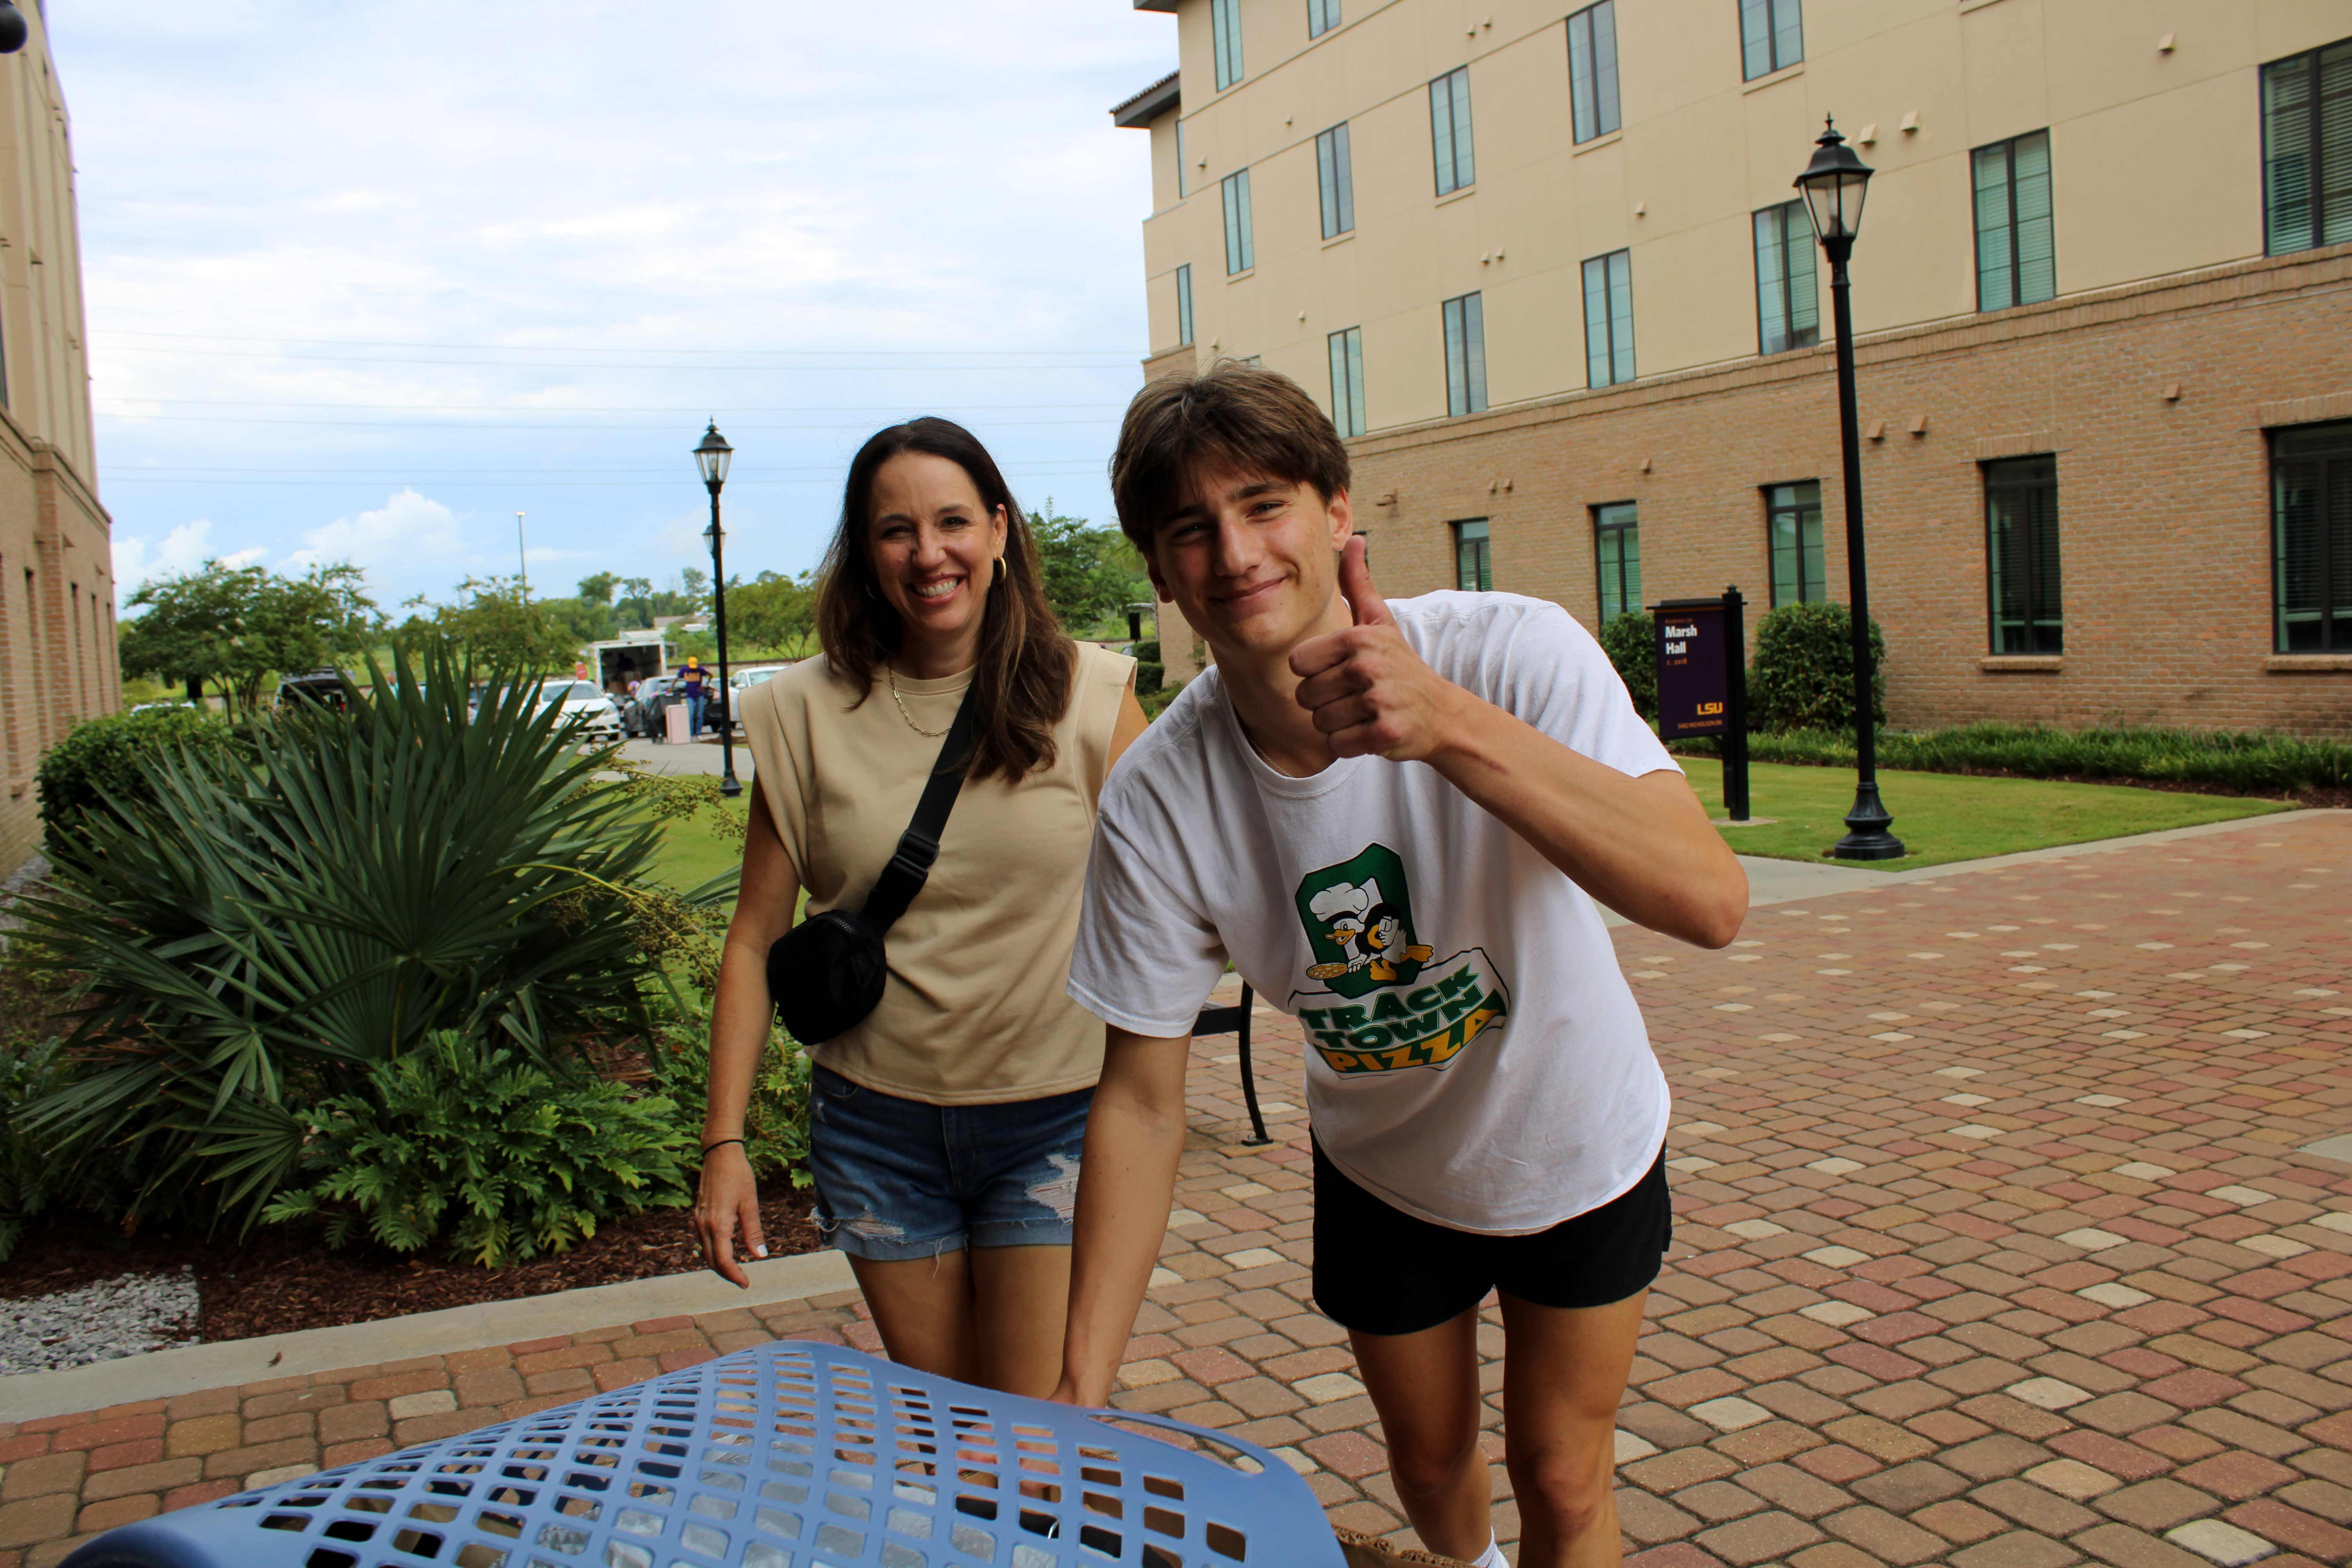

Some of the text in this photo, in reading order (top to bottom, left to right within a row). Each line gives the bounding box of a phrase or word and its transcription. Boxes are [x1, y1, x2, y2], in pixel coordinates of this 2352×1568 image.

[1665, 624, 1697, 638] Marsh
[1665, 641, 1686, 654] Hall
[1697, 702, 1723, 715] LSU
[1298, 962, 1479, 1030] TRACK
[1314, 982, 1485, 1049] TOWN
[1321, 1008, 1500, 1072] PIZZA
